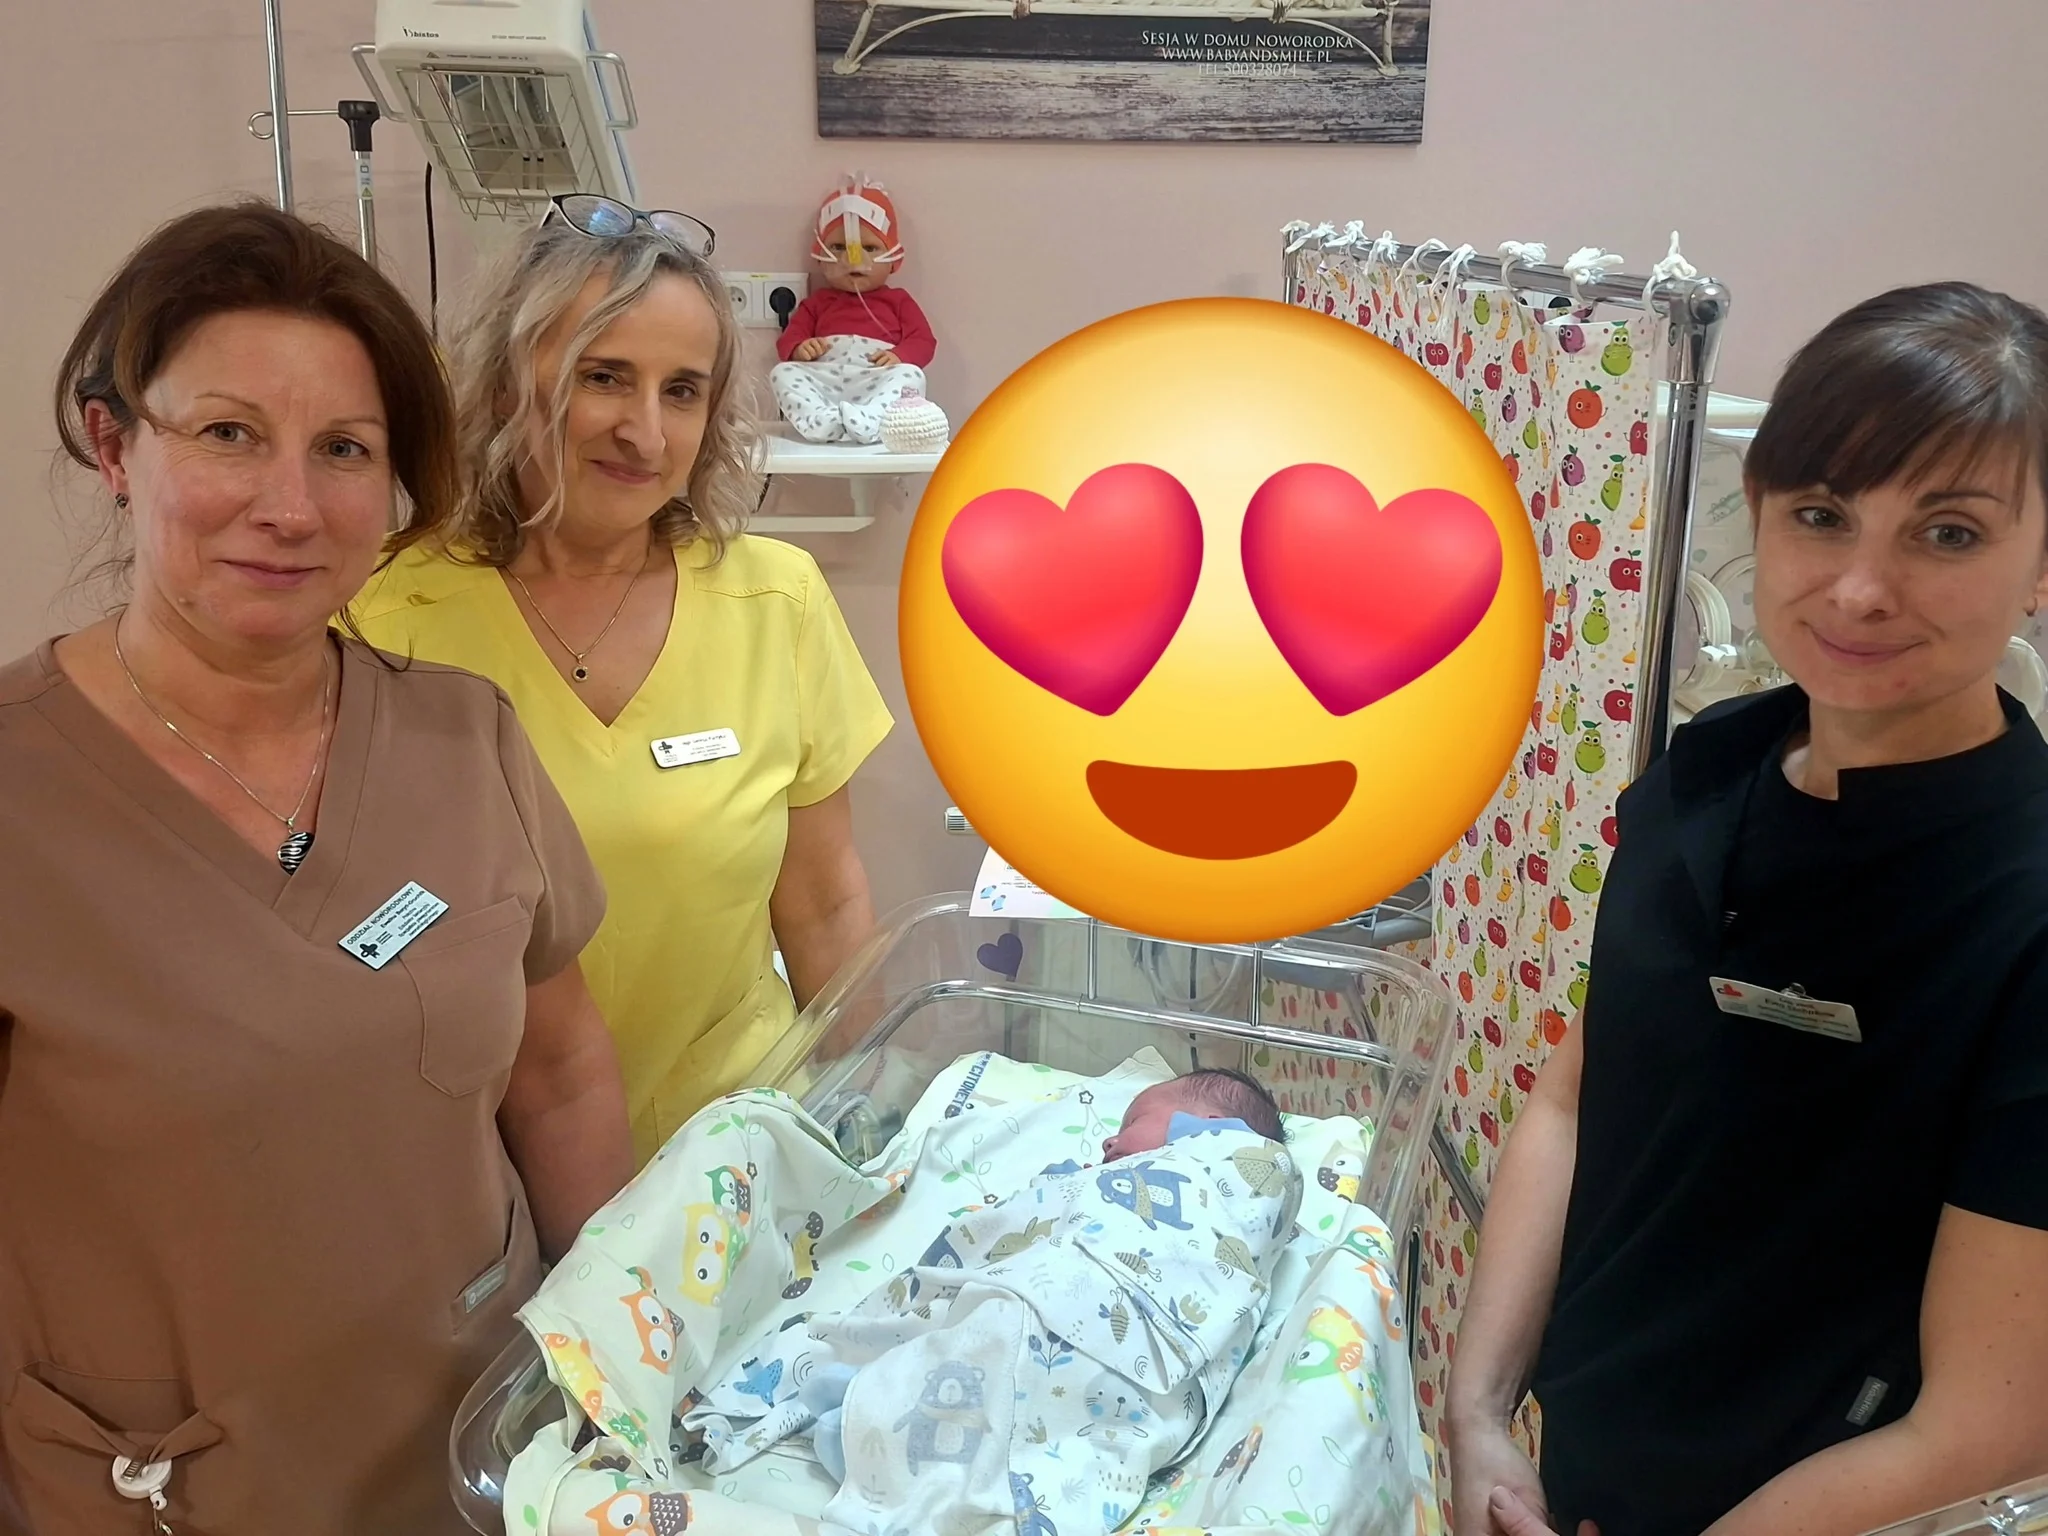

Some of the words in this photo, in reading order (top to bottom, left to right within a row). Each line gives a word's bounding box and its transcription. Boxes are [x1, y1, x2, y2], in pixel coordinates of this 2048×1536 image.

[1142, 30, 1180, 46] SESJA
[1185, 33, 1199, 45] W
[1204, 33, 1250, 46] DOMU
[1255, 34, 1353, 48] NOWORODKA
[952, 1065, 984, 1107] CITONET
